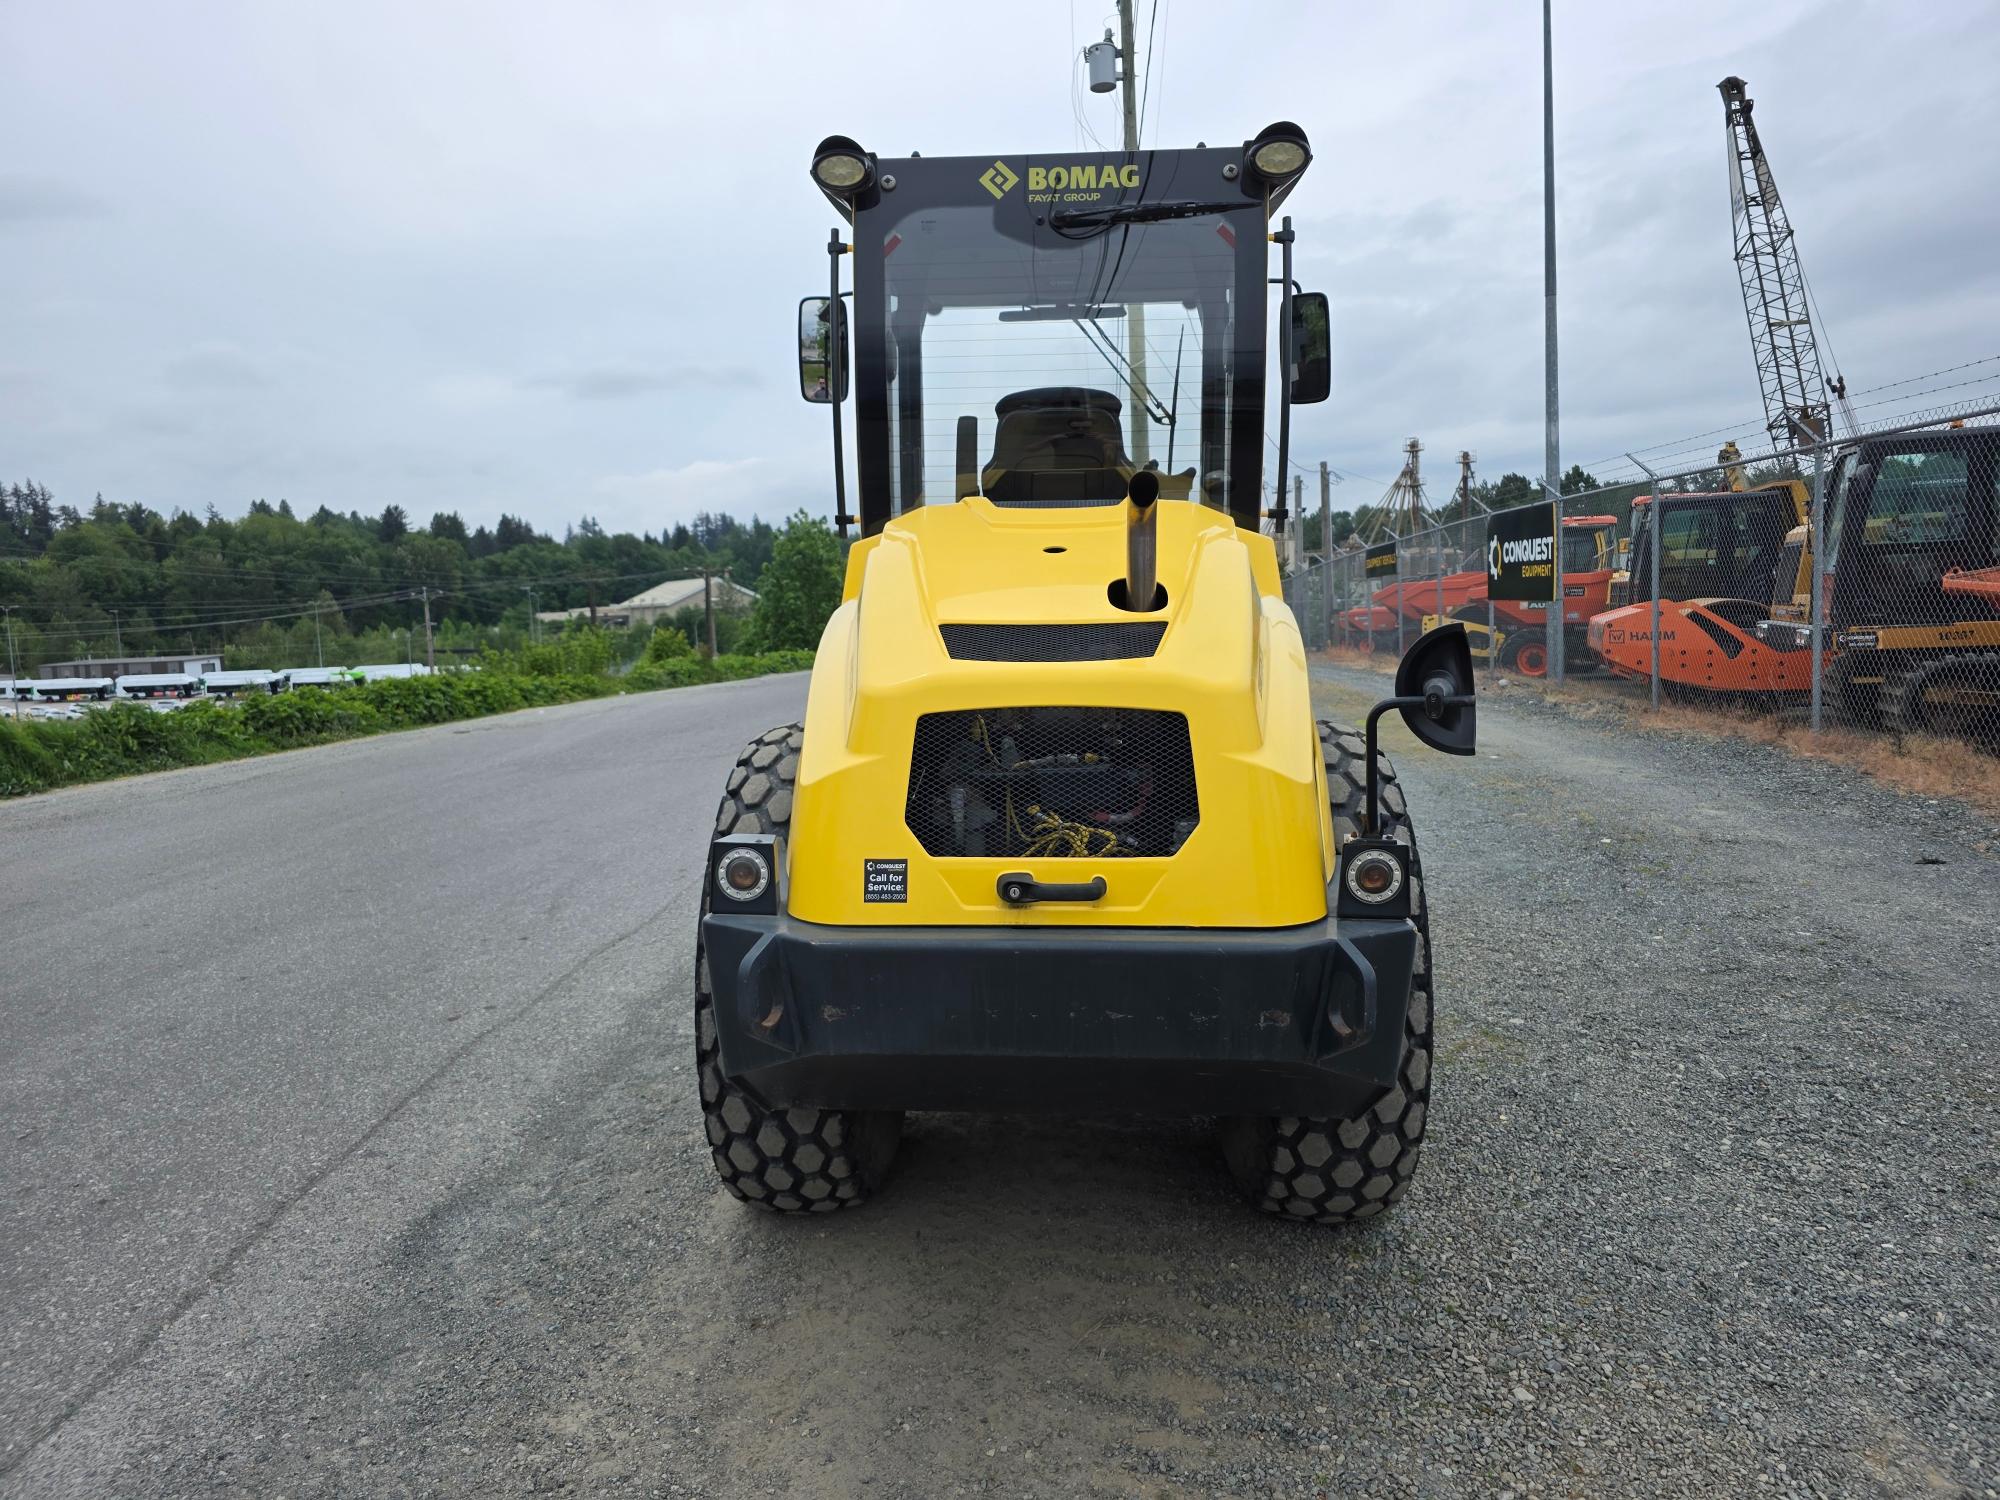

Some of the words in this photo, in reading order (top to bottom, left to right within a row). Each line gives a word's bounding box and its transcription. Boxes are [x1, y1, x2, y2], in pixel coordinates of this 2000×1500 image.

[1028, 164, 1140, 191] BOMAG
[1028, 193, 1061, 203] FAYAT
[1063, 192, 1101, 202] GROUP
[1502, 536, 1553, 563] CONQUEST
[1522, 564, 1552, 577] EQUIPMENT
[868, 883, 904, 891] Service:
